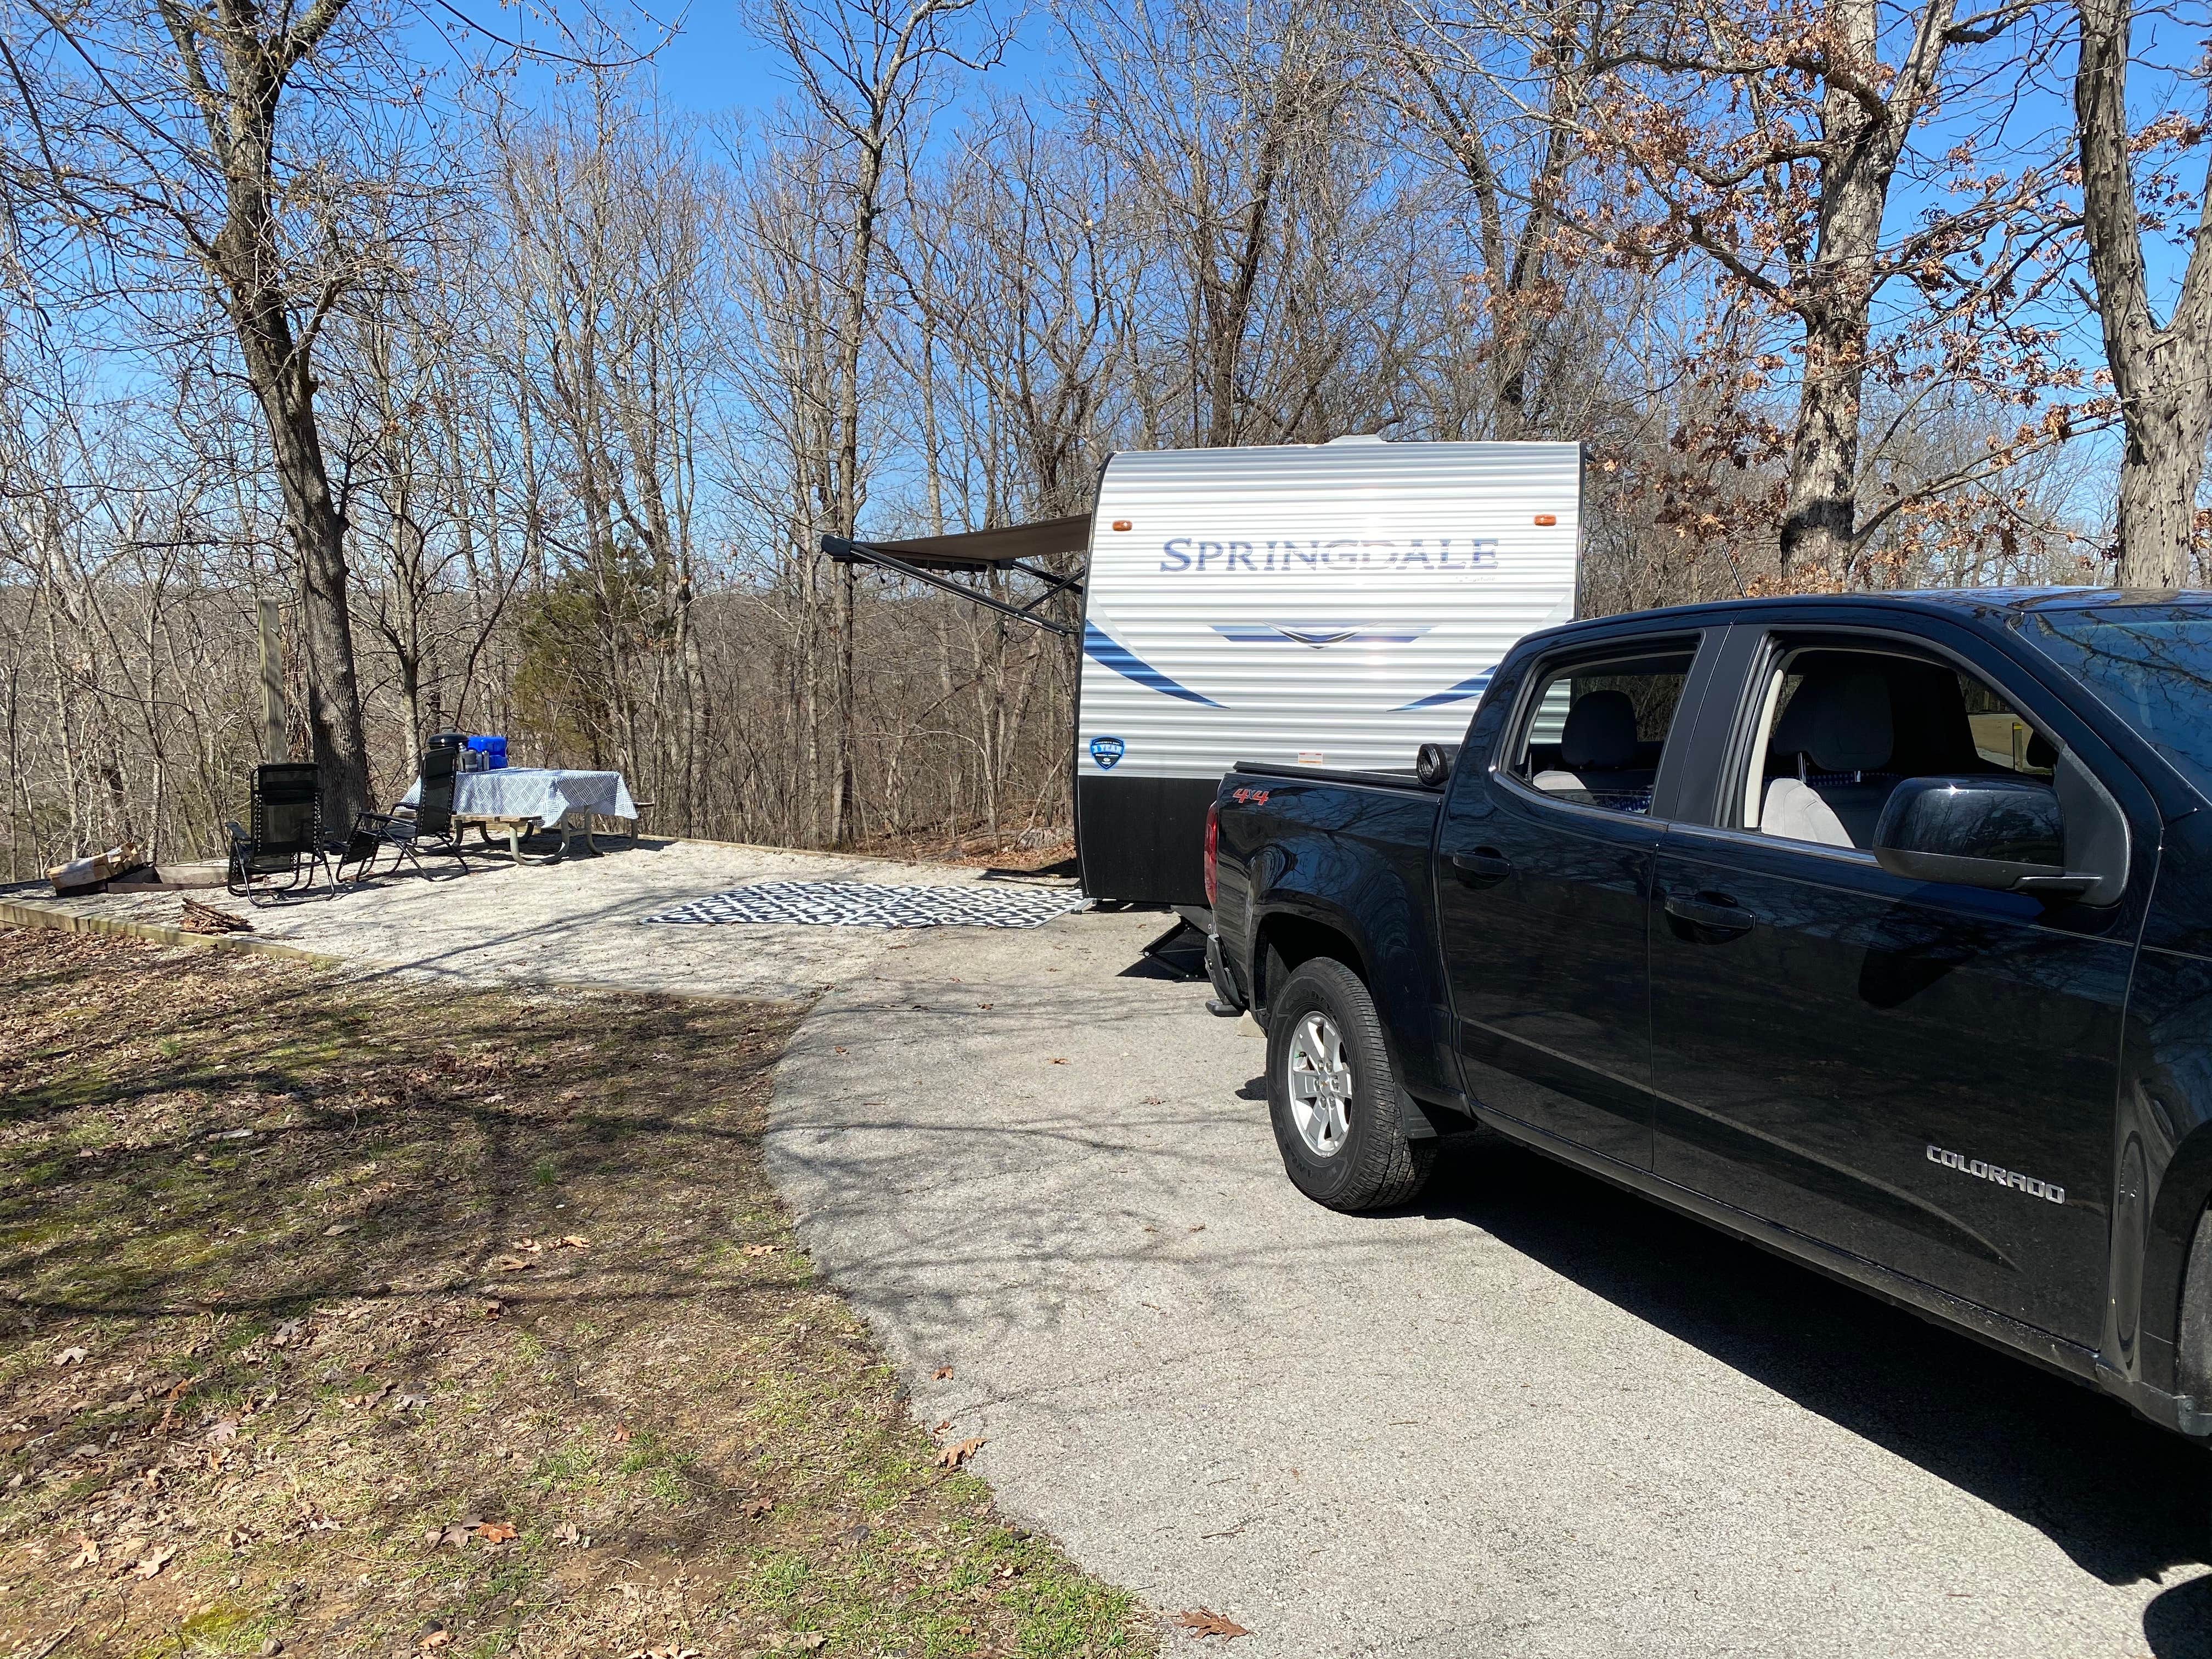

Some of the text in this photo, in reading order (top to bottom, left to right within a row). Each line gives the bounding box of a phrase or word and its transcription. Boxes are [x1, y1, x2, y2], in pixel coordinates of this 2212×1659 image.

[1160, 538, 1499, 572] SPRINGDALE
[1099, 744, 1122, 754] YEAR
[1926, 1145, 2065, 1204] COLORADO
